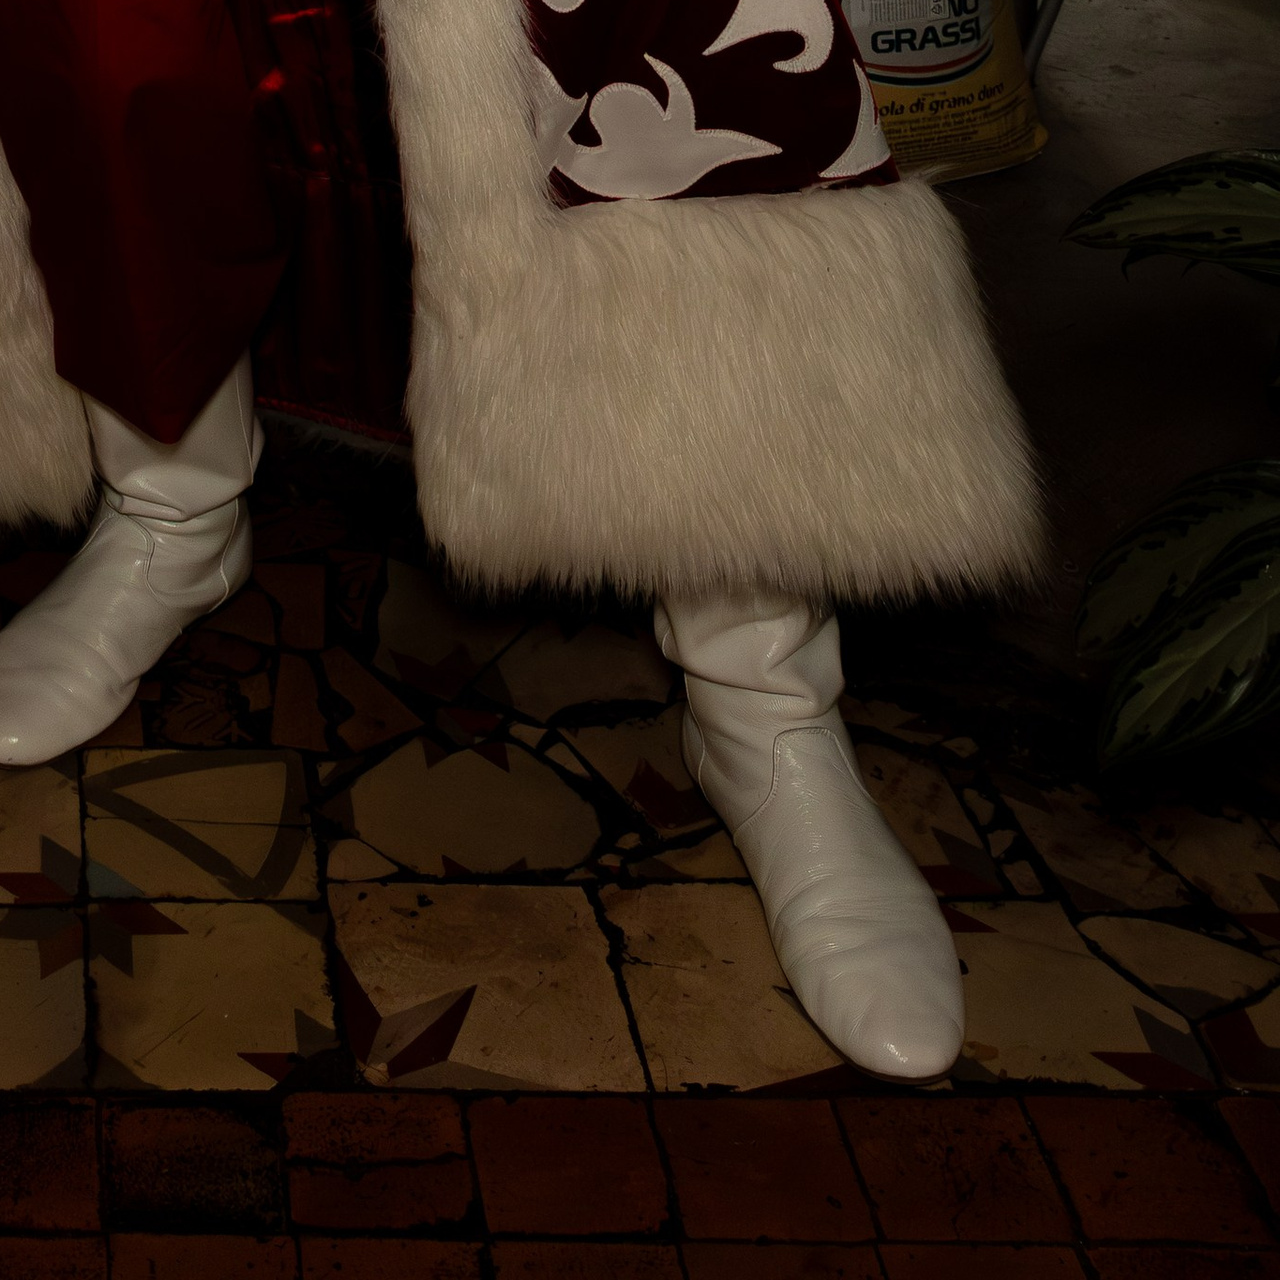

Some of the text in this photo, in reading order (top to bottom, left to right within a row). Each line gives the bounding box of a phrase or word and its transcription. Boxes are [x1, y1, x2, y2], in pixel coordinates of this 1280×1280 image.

[871, 16, 981, 54] GRASSI
[879, 100, 905, 117] ola
[910, 97, 925, 113] di
[930, 92, 975, 115] grano
